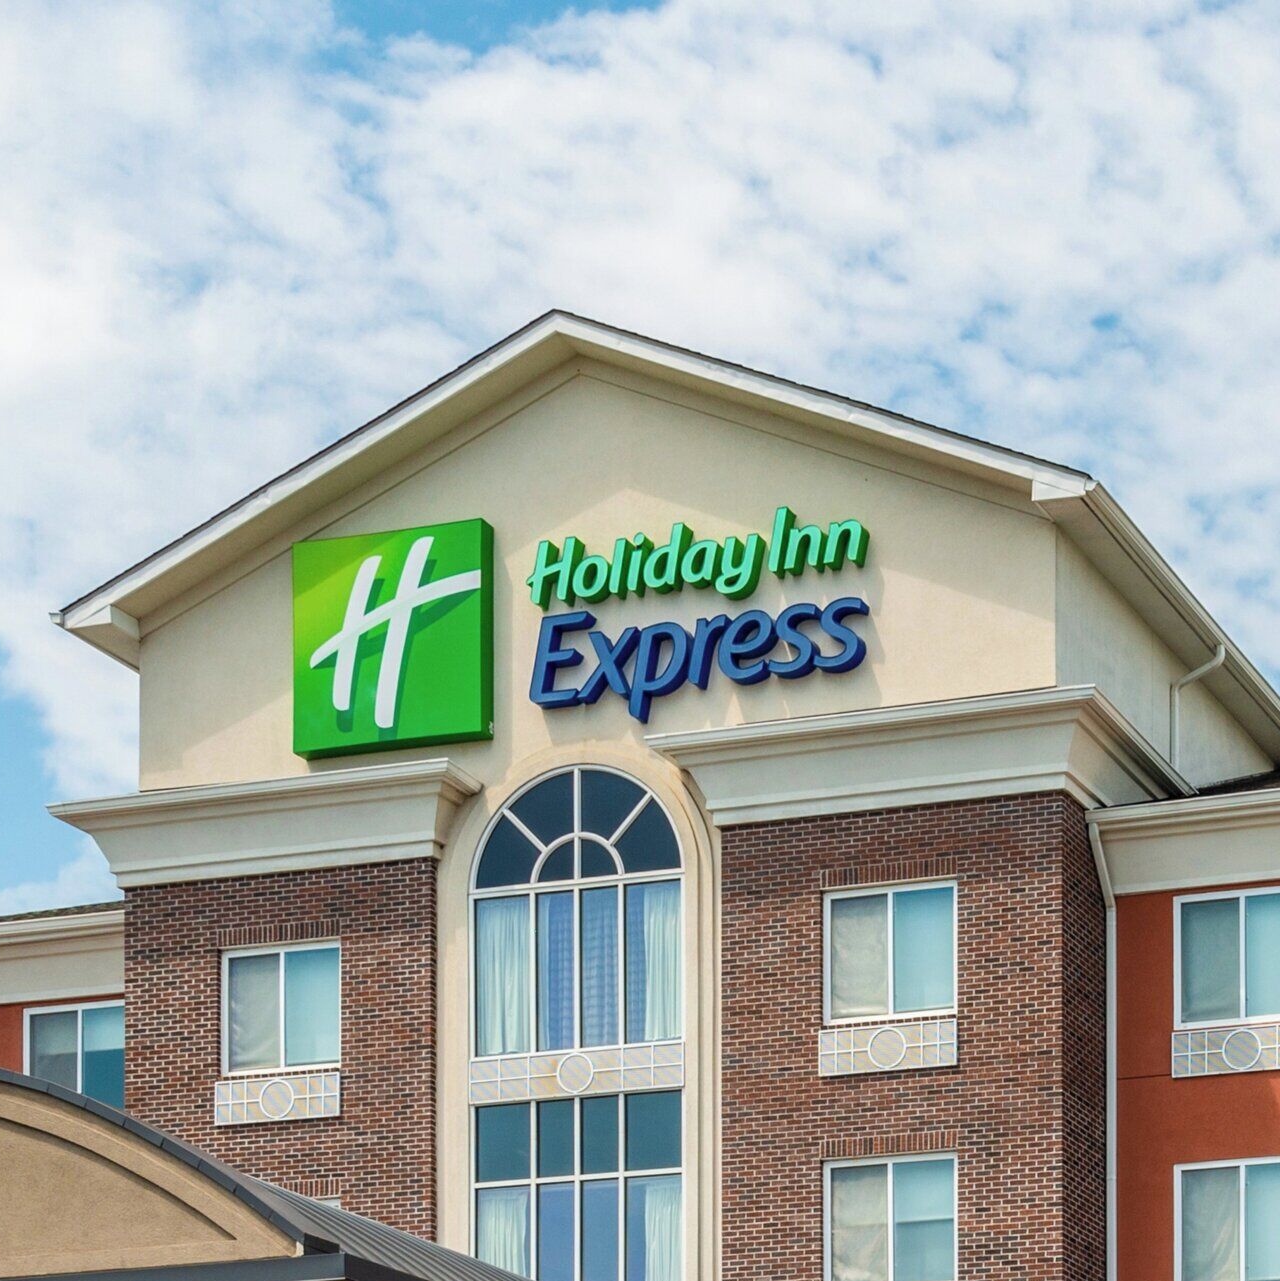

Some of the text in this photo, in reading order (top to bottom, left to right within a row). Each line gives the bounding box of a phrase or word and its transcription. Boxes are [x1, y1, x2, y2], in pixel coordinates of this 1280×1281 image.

[526, 506, 870, 608] Holiday Inn
[529, 597, 870, 724] Express
